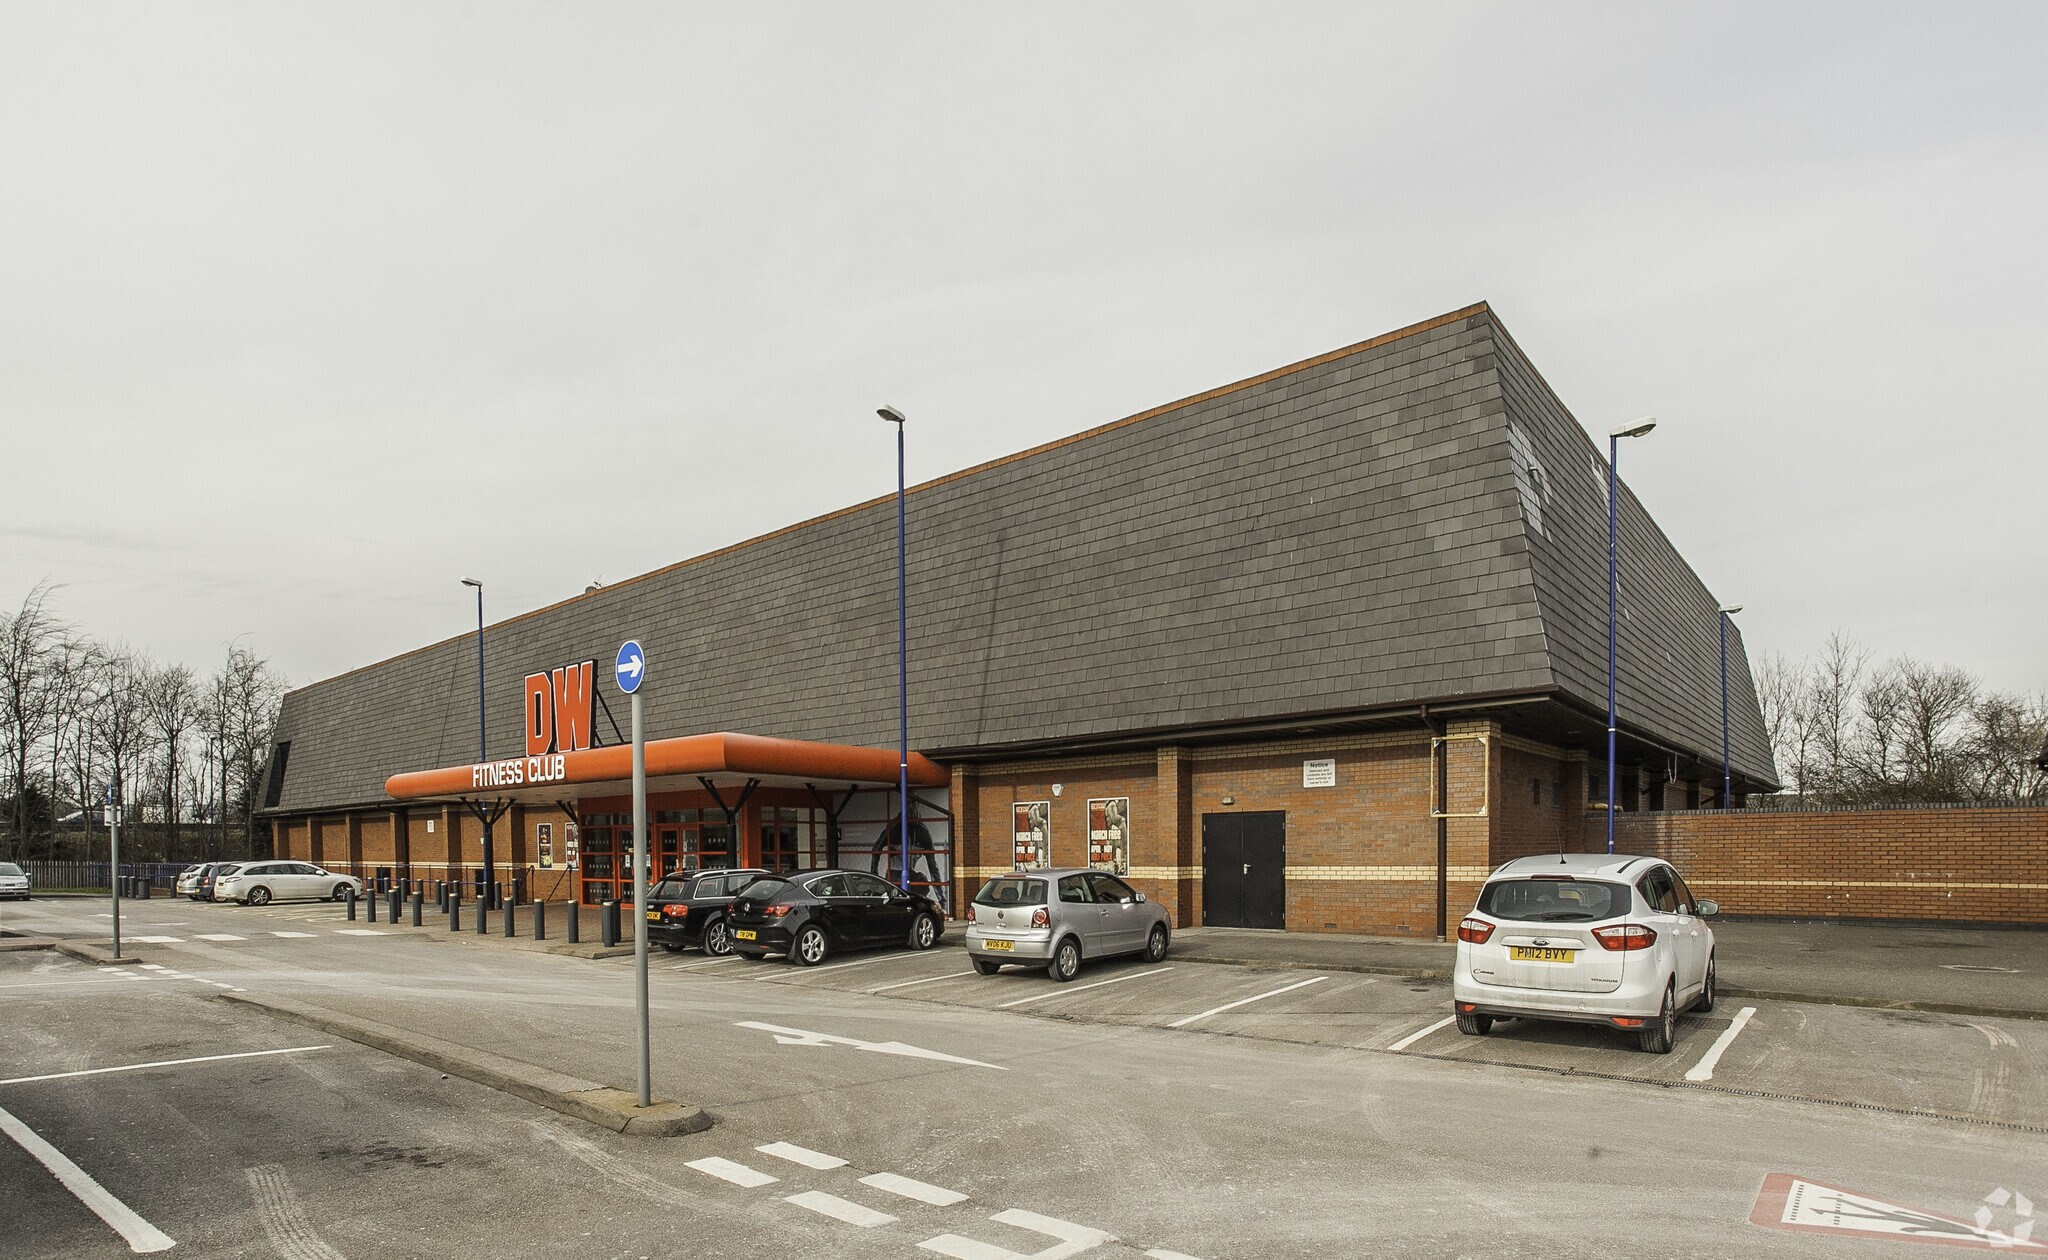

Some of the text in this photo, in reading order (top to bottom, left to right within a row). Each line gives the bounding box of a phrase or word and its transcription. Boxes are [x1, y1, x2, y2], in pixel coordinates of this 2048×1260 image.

[525, 660, 594, 757] DW
[472, 755, 565, 787] FITNESS CLUB
[1544, 949, 1567, 960] BVY
